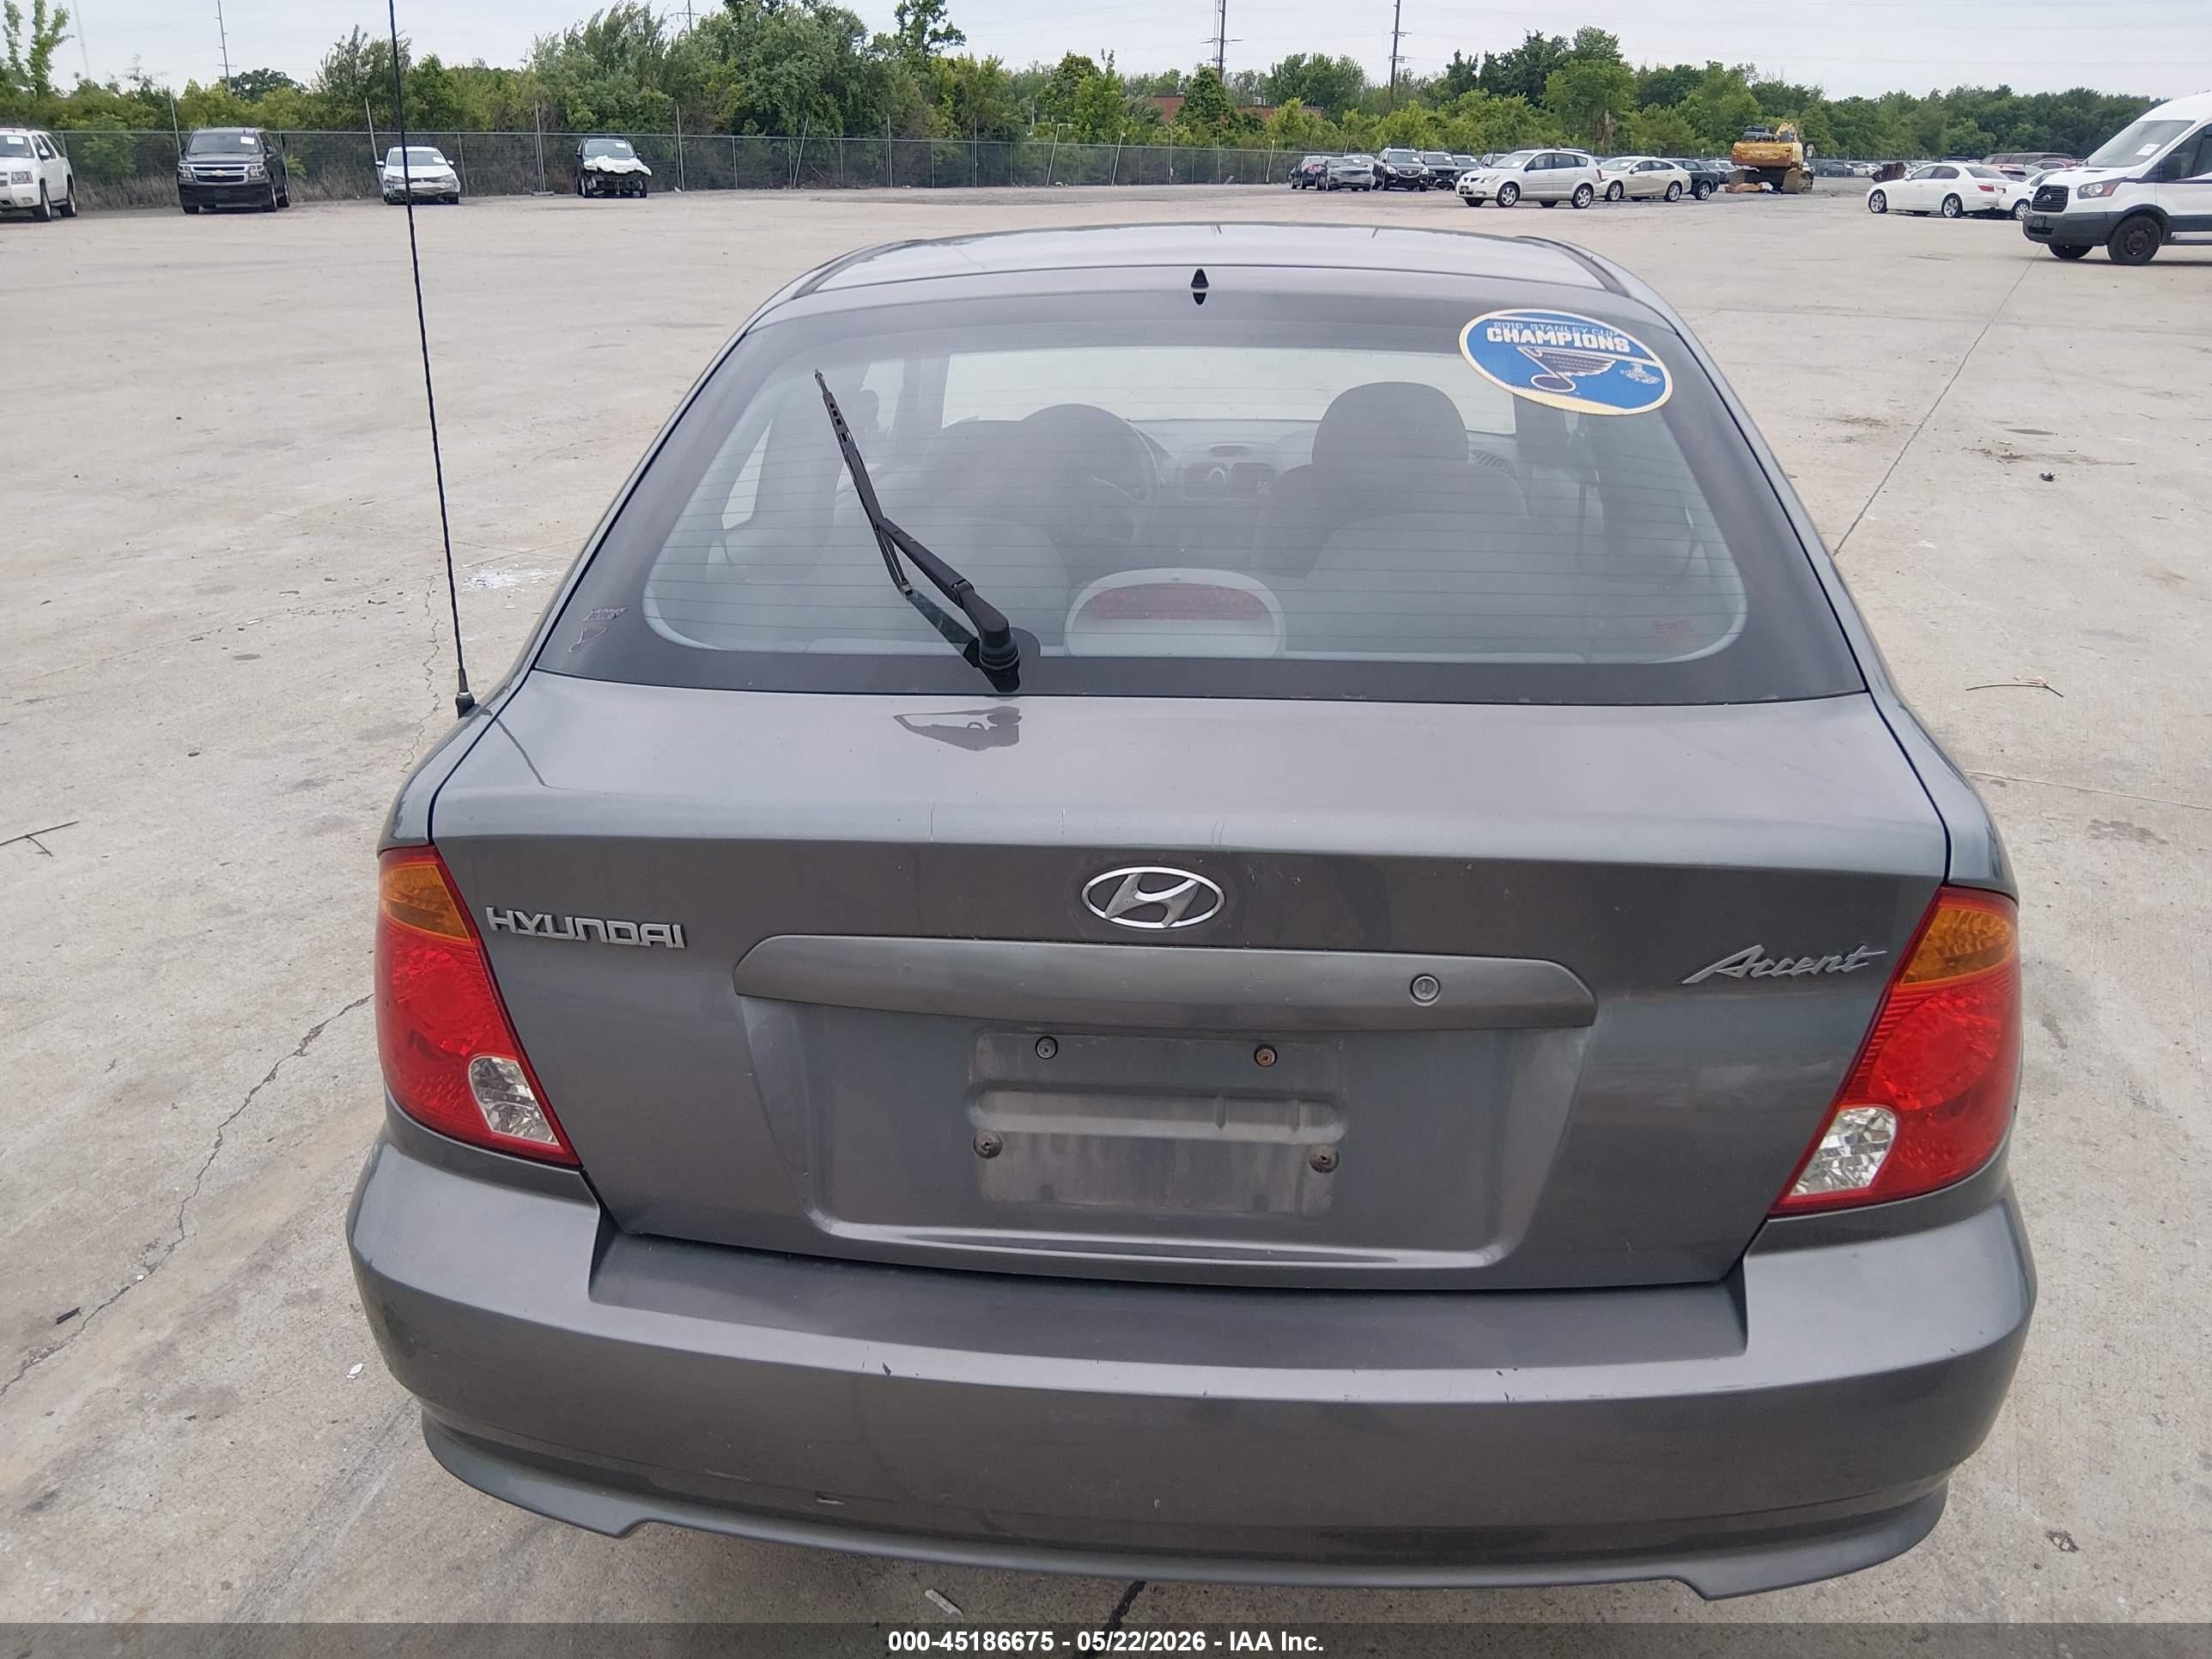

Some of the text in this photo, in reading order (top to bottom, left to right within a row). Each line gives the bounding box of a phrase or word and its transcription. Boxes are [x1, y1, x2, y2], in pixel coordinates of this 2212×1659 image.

[1486, 326, 1631, 353] CHAMPIONS
[1529, 323, 1589, 335] STANLEY
[1591, 328, 1618, 338] CUP
[485, 905, 686, 949] HYUNDAI
[1679, 944, 1888, 985] Accent
